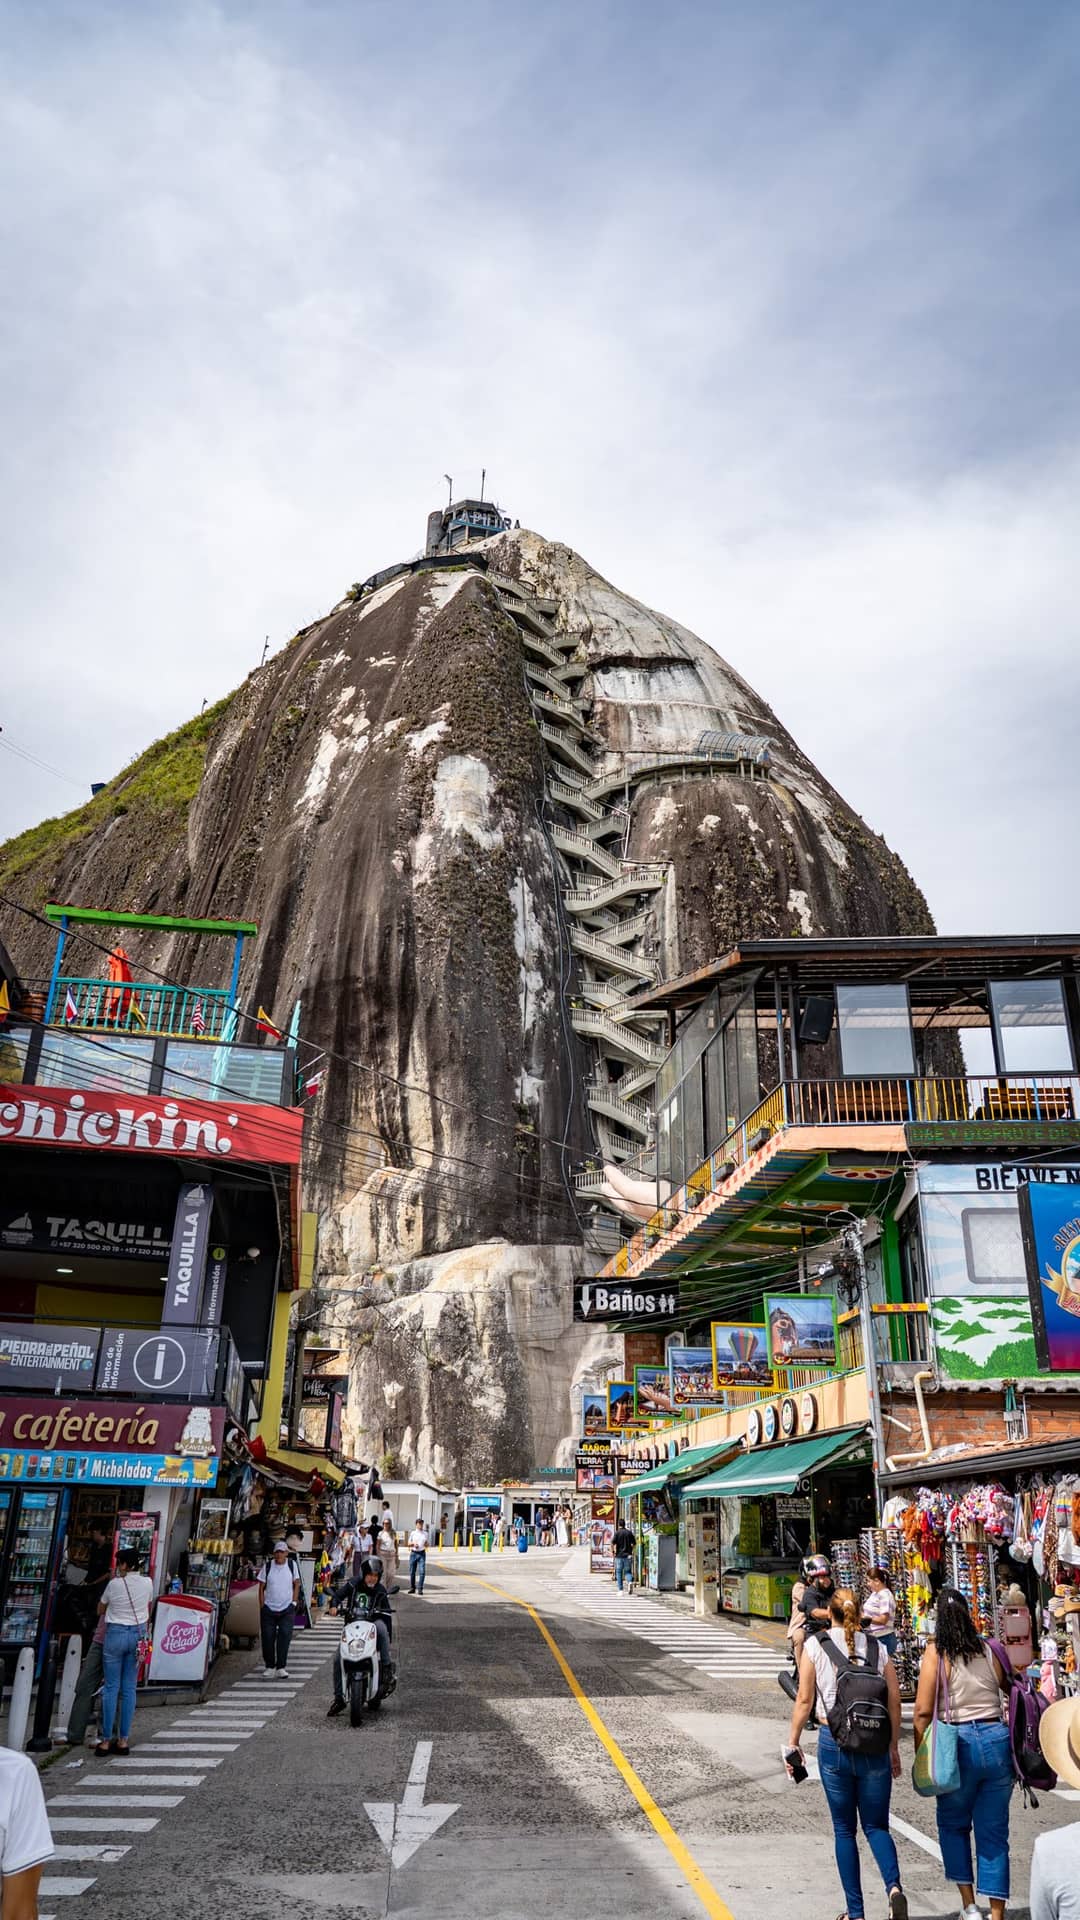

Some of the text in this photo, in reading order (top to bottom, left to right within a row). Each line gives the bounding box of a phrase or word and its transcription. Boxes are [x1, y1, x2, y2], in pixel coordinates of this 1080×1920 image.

[46, 1216, 172, 1248] TAQUILL
[173, 1212, 199, 1306] TAQUILLA
[207, 1264, 221, 1321] Información
[596, 1287, 655, 1312] Baños
[0, 1339, 46, 1356] PIEDRA
[53, 1342, 95, 1359] PEÑOL
[110, 1333, 125, 1389] Información
[11, 1354, 82, 1371] ENTERTAINMENT
[101, 1346, 115, 1389] Punto de
[13, 1406, 160, 1450] cafetería
[91, 1459, 153, 1479] Micheladas
[620, 1459, 650, 1469] BAÑOS
[165, 1634, 200, 1652] Helado
[169, 1624, 198, 1638] Crem
